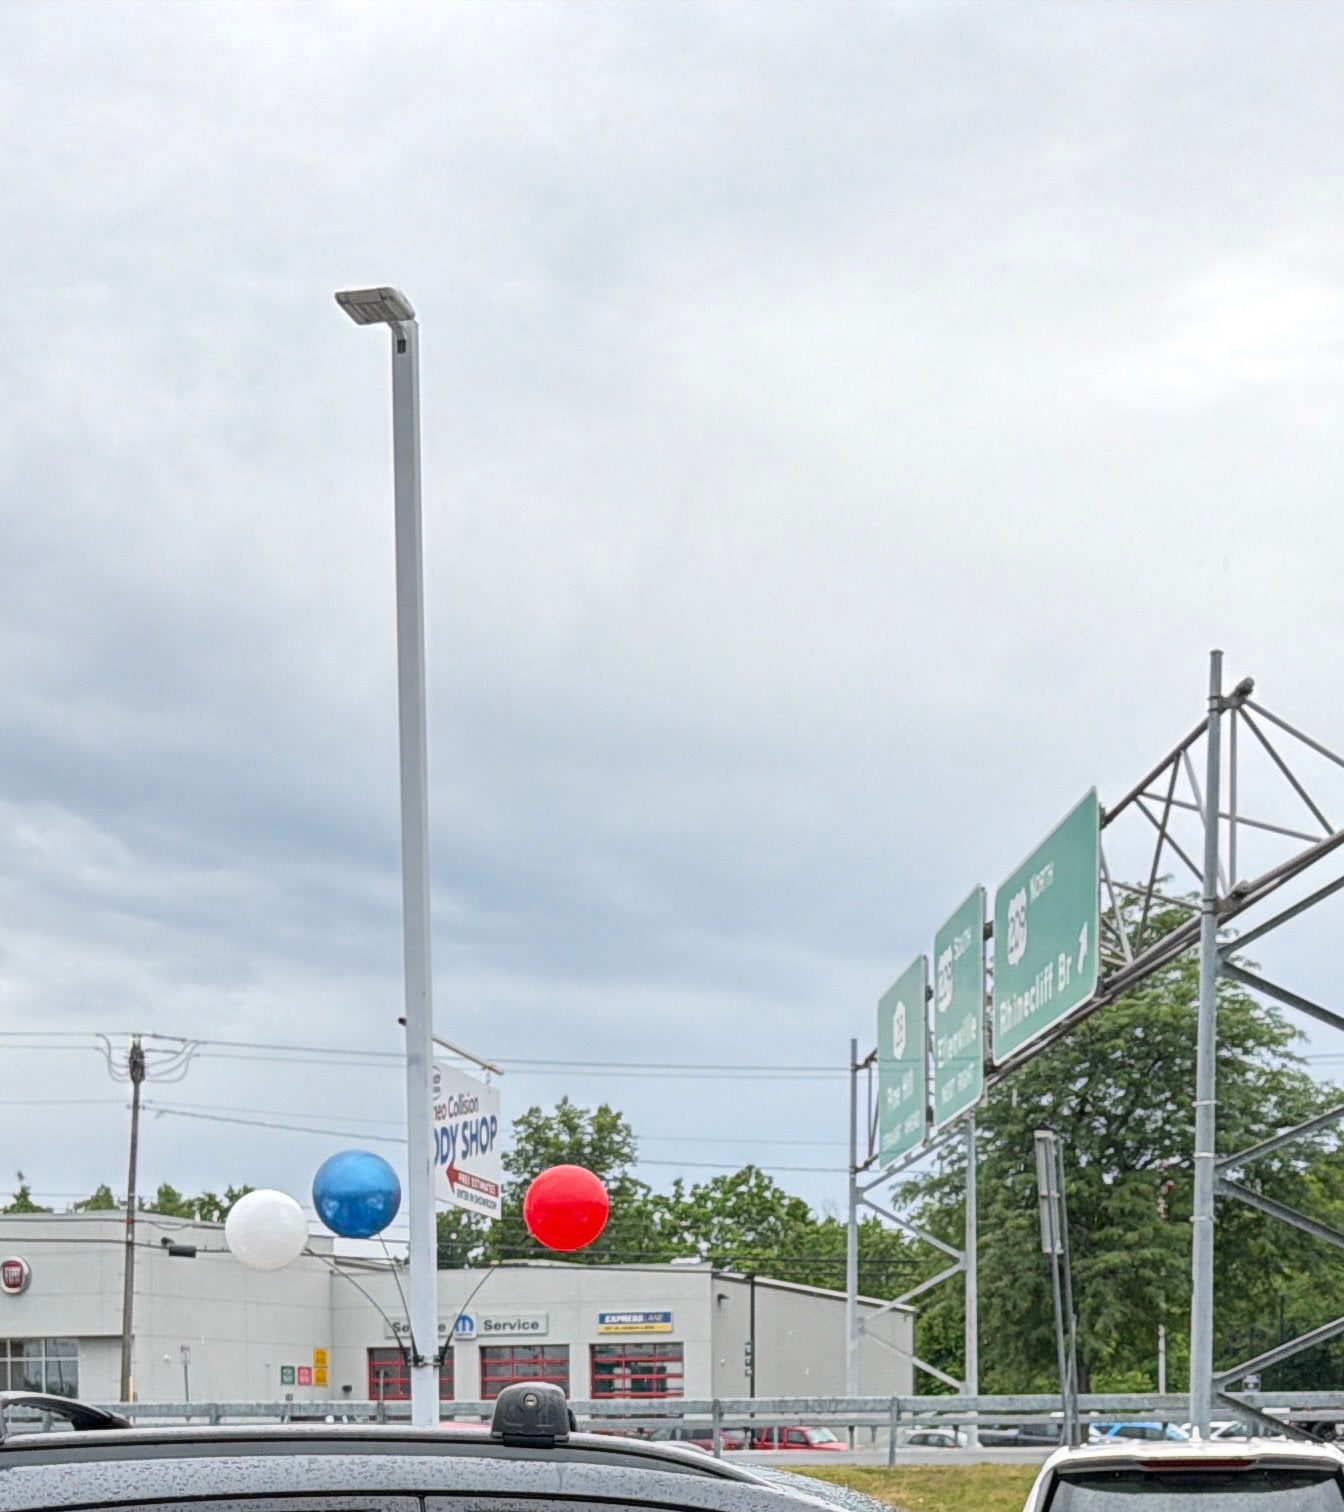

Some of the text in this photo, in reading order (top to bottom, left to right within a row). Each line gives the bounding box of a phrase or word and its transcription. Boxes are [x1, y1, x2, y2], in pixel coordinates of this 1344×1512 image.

[1000, 952, 1072, 1037] Rhinecliff Br
[448, 1092, 479, 1119] Collision
[461, 1115, 498, 1160] SHOP
[483, 1319, 540, 1331] Service
